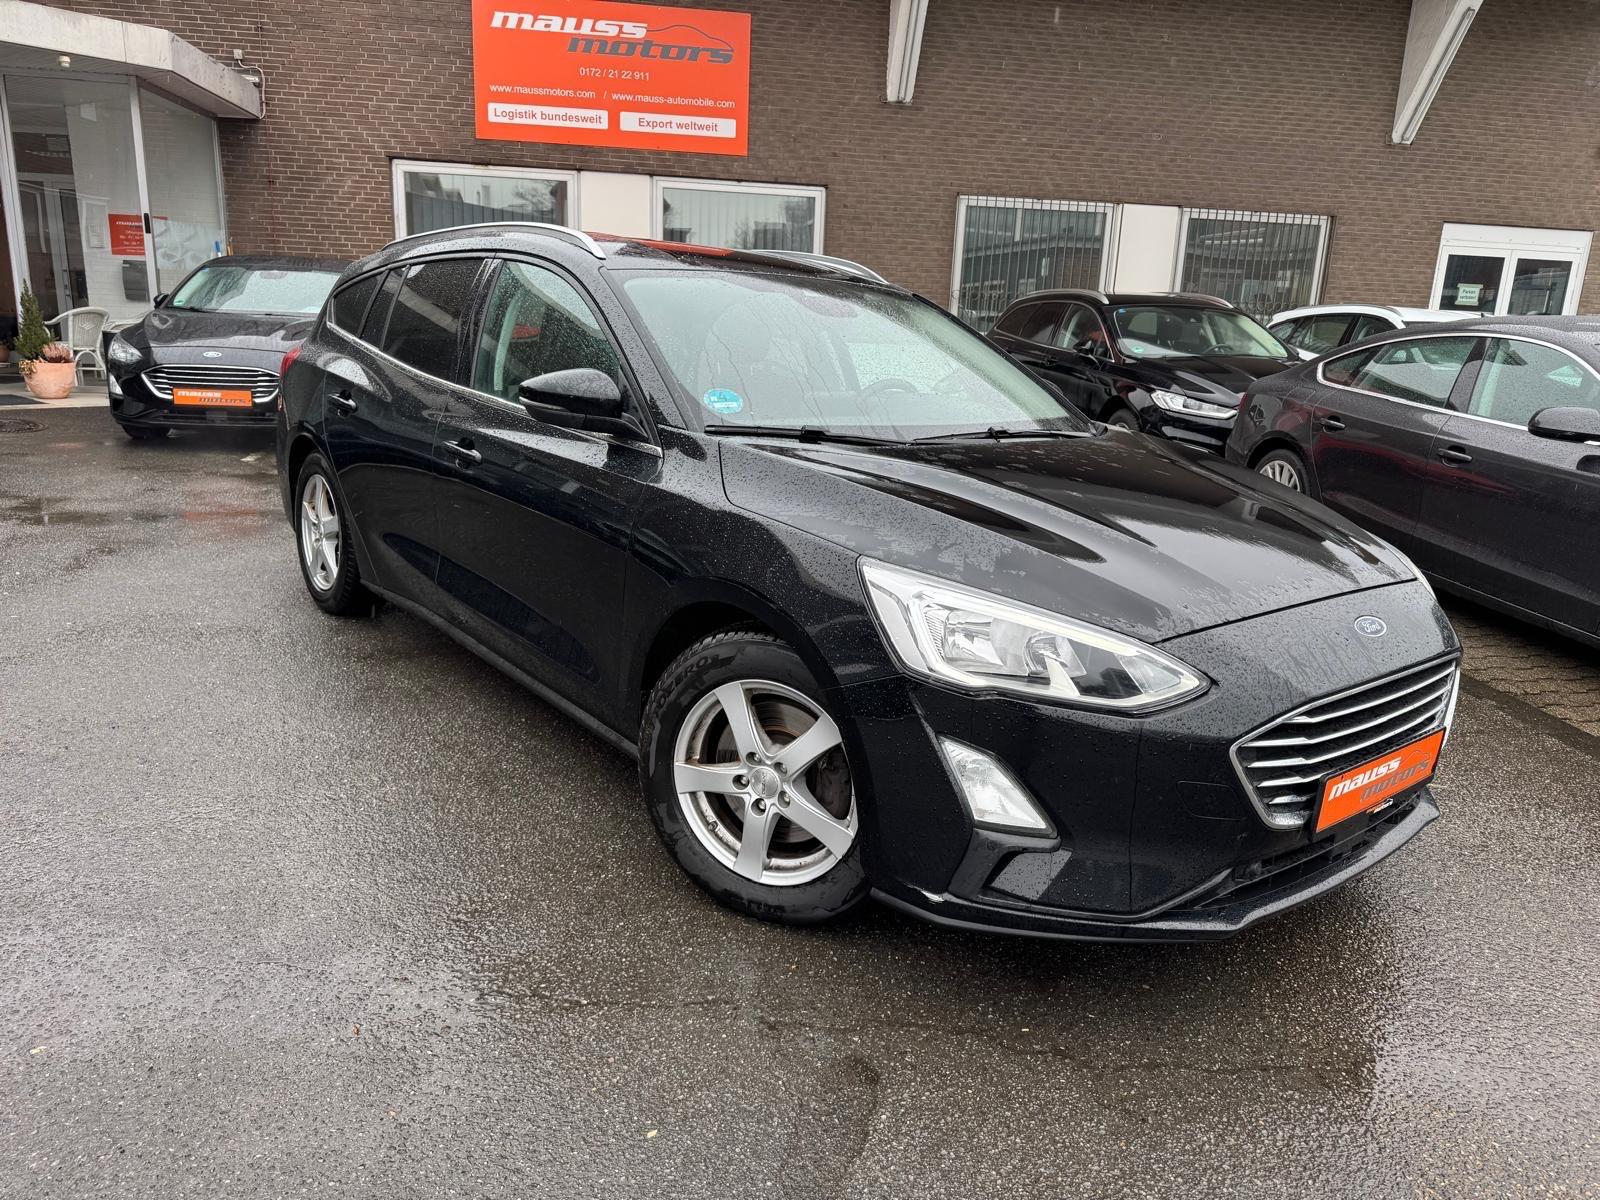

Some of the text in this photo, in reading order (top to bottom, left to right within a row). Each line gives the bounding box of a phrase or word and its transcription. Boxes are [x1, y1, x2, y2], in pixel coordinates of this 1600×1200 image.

[490, 11, 648, 38] mauss
[567, 37, 734, 64] motors
[579, 67, 650, 80] 0172 / 21 22 911
[489, 84, 736, 108] www.maussmotors.com / www.mauss-automobile.com
[494, 107, 603, 124] Logistik bundesweit
[638, 117, 719, 132] Export weltweit
[1327, 756, 1402, 801] mauss
[1360, 761, 1429, 803] motors
